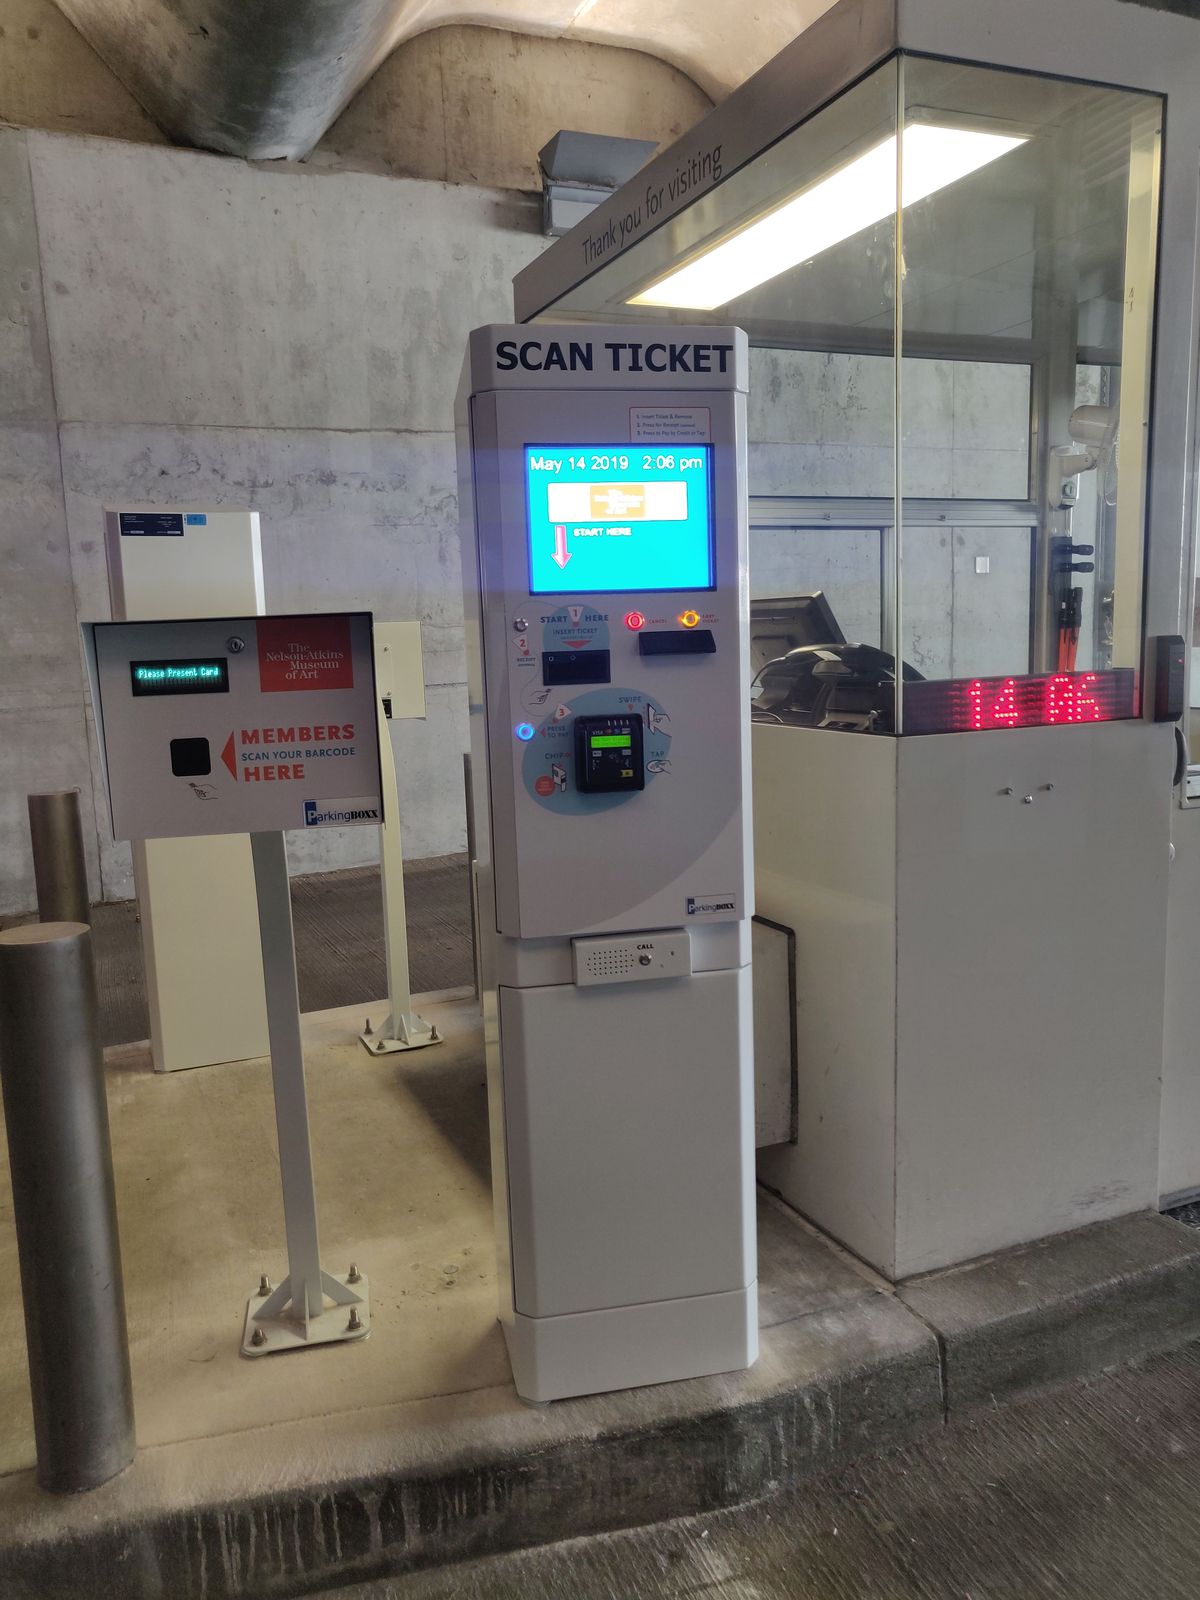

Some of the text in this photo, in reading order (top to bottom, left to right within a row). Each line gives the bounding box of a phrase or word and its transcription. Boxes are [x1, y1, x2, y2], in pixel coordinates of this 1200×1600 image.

[582, 144, 722, 264] Thank you for visiting
[496, 341, 734, 373] SCAN TICKET
[530, 455, 702, 474] May 14 2019 2:06 pm
[573, 527, 632, 537] START HERE
[573, 608, 578, 617] 1
[540, 614, 609, 624] START HERE
[288, 643, 310, 653] The
[520, 639, 526, 647] 2
[266, 650, 344, 662] Nelson-Atkins
[290, 660, 339, 670] Museum
[138, 667, 219, 679] Please Present Card
[285, 670, 319, 680] of Art
[241, 724, 355, 745] MEMBERS
[242, 747, 356, 761] SCAN YOUR BARCODE
[244, 764, 305, 782] HERE
[307, 809, 379, 823] ParkingBOXX
